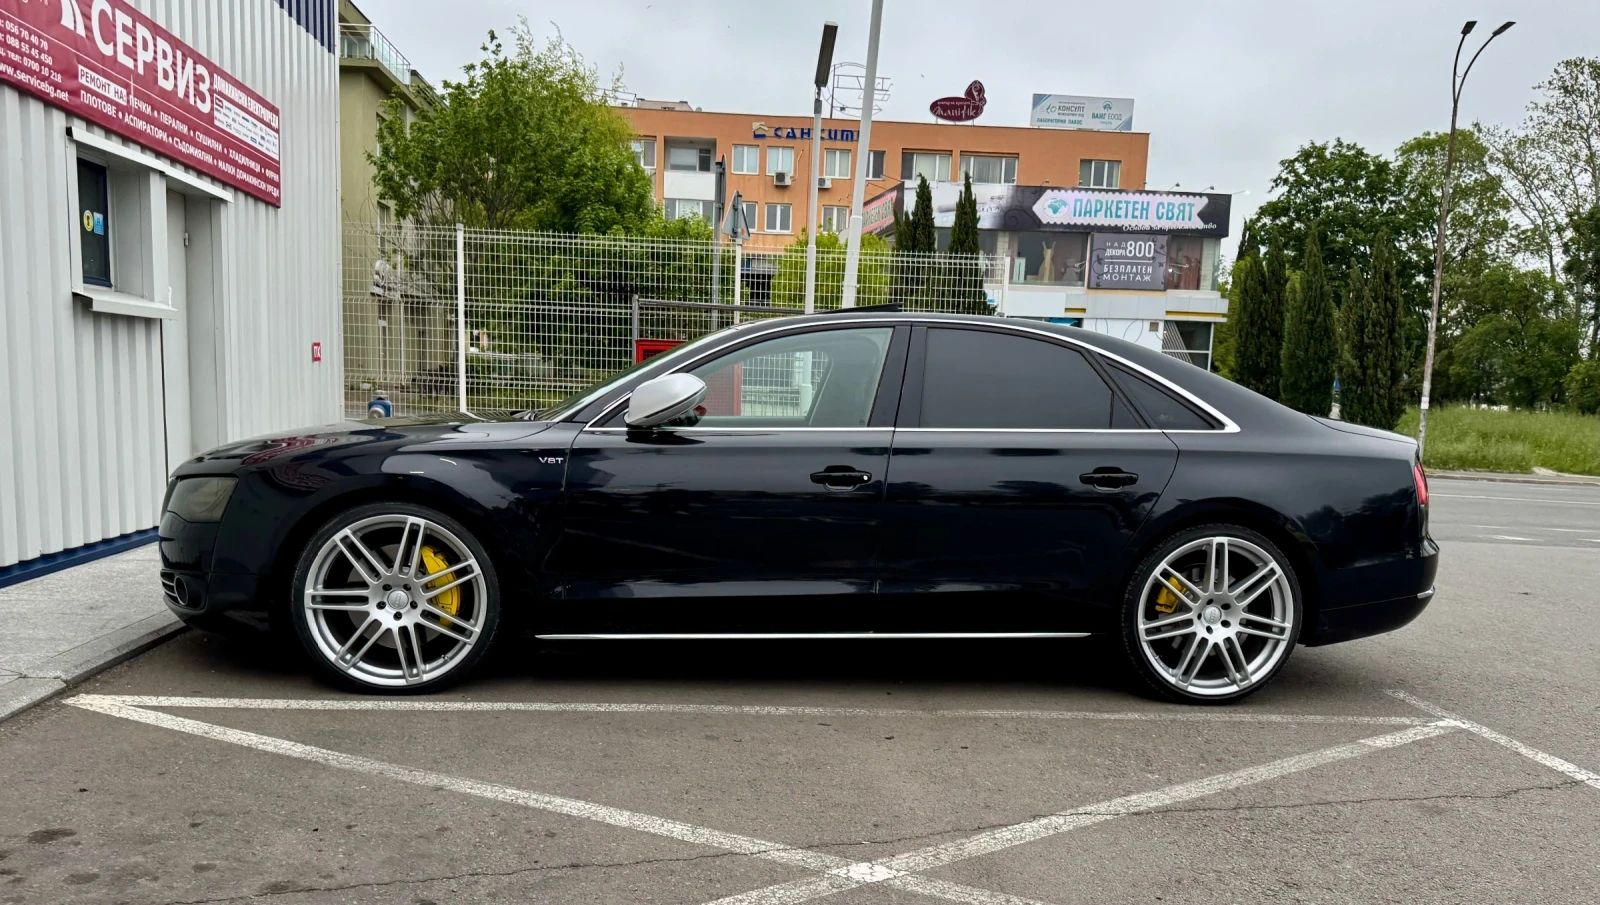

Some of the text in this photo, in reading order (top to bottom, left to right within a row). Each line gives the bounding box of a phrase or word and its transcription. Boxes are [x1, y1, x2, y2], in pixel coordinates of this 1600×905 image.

[6, 20, 19, 34] 056
[20, 28, 29, 40] 70
[30, 34, 39, 46] 40
[40, 38, 48, 50] 70
[6, 34, 20, 48] 088
[21, 42, 30, 54] 55
[31, 48, 40, 58] 45
[40, 53, 52, 66] 450
[91, 0, 211, 114] СЕРВИЗ
[23, 56, 40, 72] 0700
[41, 66, 49, 77] 10
[50, 70, 62, 83] 218
[80, 69, 110, 94] РЕМОНТ
[129, 94, 152, 116] ПЕЧКИ
[160, 112, 188, 136] ПЕРАЛНИ
[196, 131, 222, 153] СУШИЛНИ
[81, 90, 116, 118] ПЛОТОВЕ
[124, 112, 168, 142] АСПИРАТОРИ
[174, 137, 214, 165] СЪДОМИЯЛНИ
[218, 159, 236, 176] МАЛКИ
[1072, 198, 1195, 221] ПАРКЕТЕН СВЯТ
[1126, 241, 1154, 257] 800
[1102, 274, 1152, 282] МОНТАЖ
[1104, 264, 1152, 274] БЕЗПЛАТЕН
